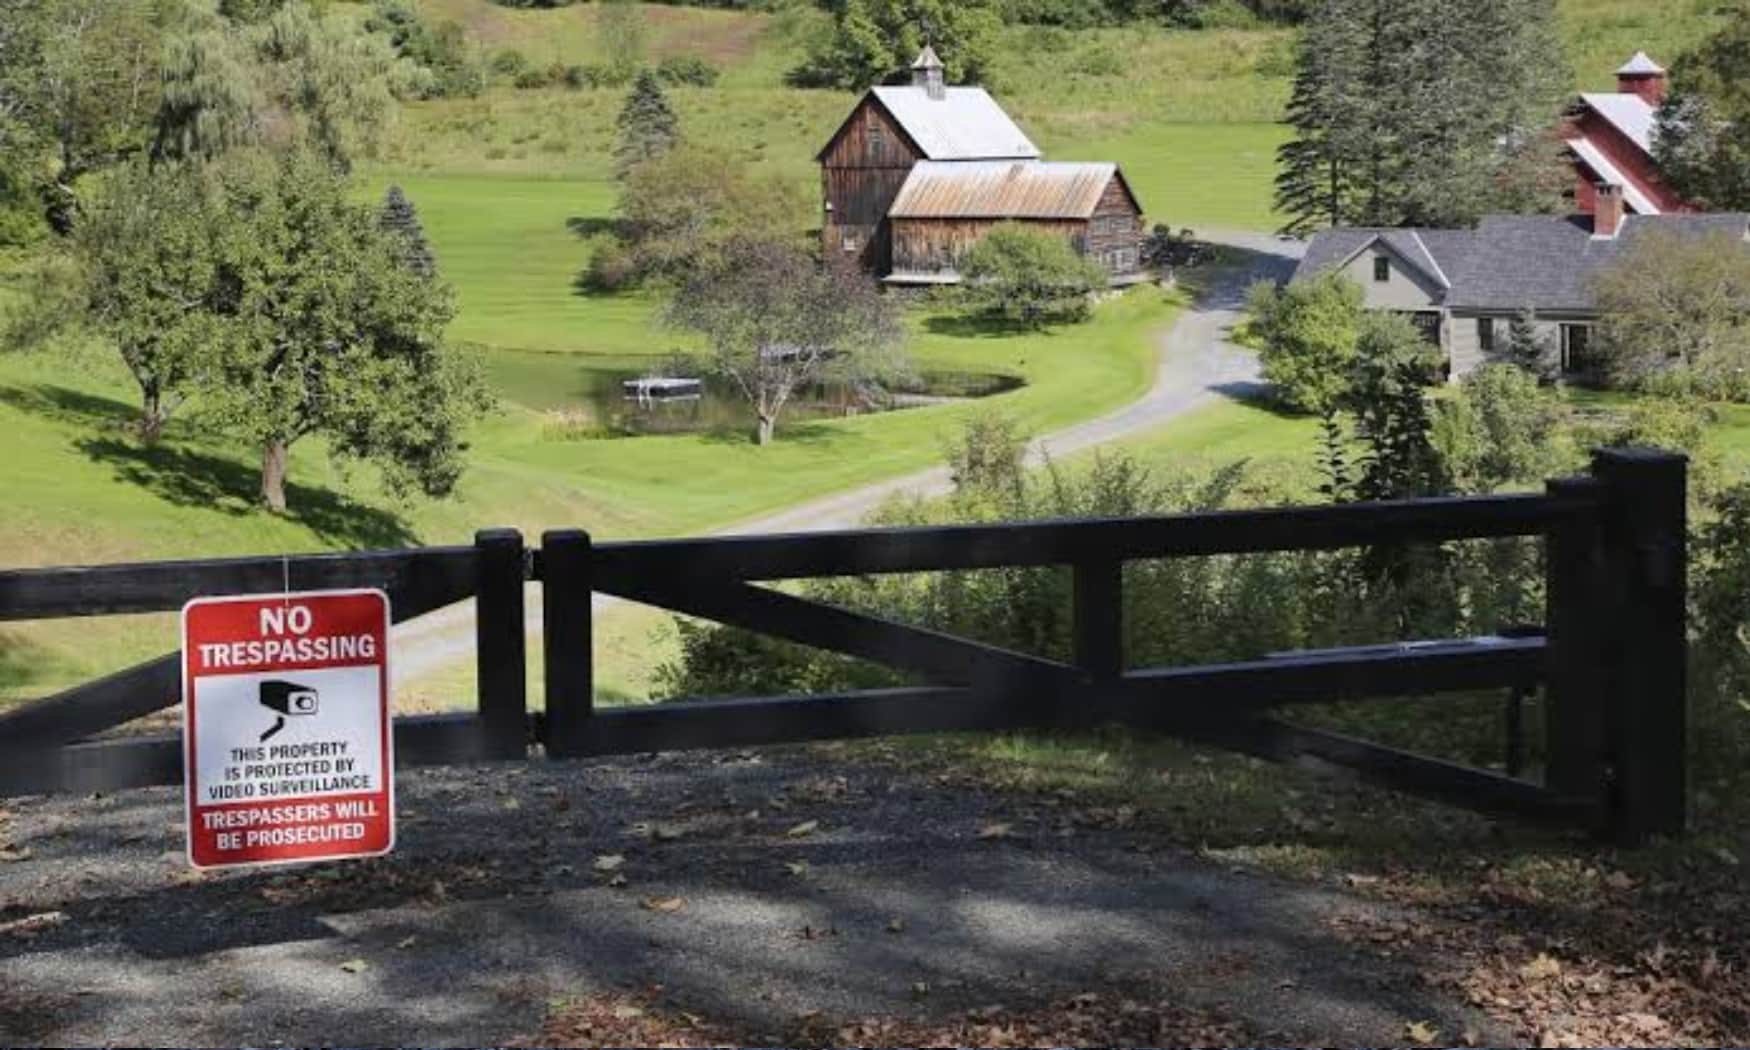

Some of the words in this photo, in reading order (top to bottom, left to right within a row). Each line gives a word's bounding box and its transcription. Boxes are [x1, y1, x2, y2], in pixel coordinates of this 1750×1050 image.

[260, 605, 312, 635] NO
[198, 634, 375, 667] TRESPASSING
[230, 747, 266, 762] THIS
[270, 741, 348, 759] PROPERTY
[224, 766, 241, 781] IS
[245, 759, 331, 779] PROTECTED
[336, 758, 355, 772] BY
[209, 785, 254, 800] VIDEO
[259, 774, 371, 797] SURVEILLANCE
[201, 803, 331, 829] TRESPASSERS
[336, 801, 379, 818] WILL
[216, 833, 241, 850] BE
[247, 823, 365, 847] PROSECUTED
